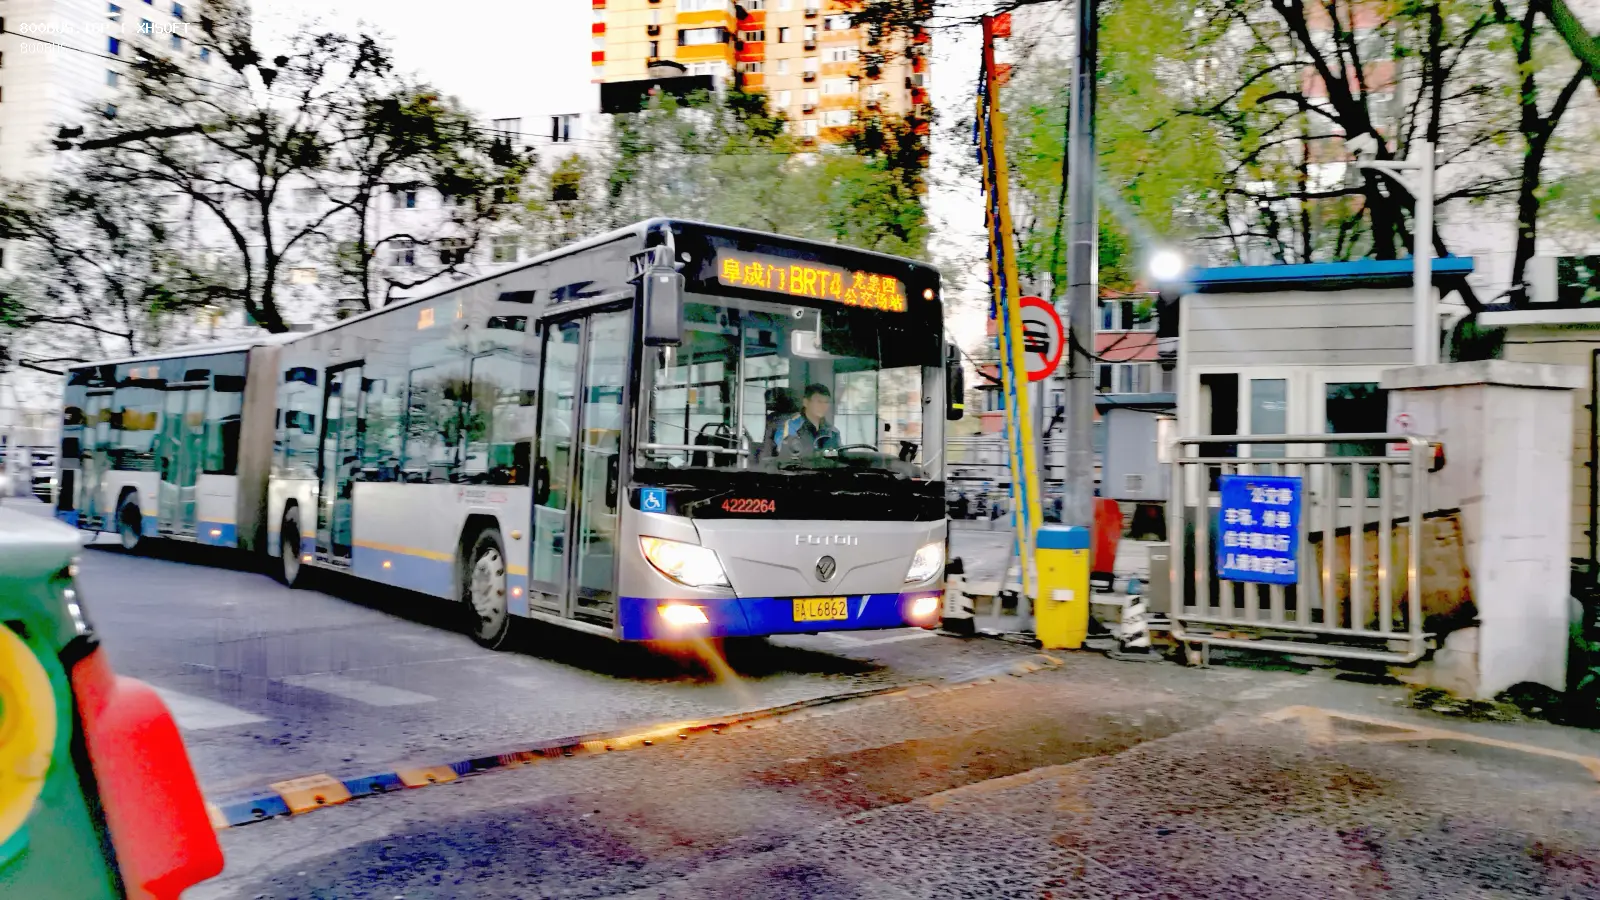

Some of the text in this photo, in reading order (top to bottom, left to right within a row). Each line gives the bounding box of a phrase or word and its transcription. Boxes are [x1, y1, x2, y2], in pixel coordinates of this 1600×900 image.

[721, 257, 786, 289] 阜成门
[789, 264, 842, 299] BRT4
[844, 288, 905, 312] 公交场站
[721, 499, 776, 513] 4222264
